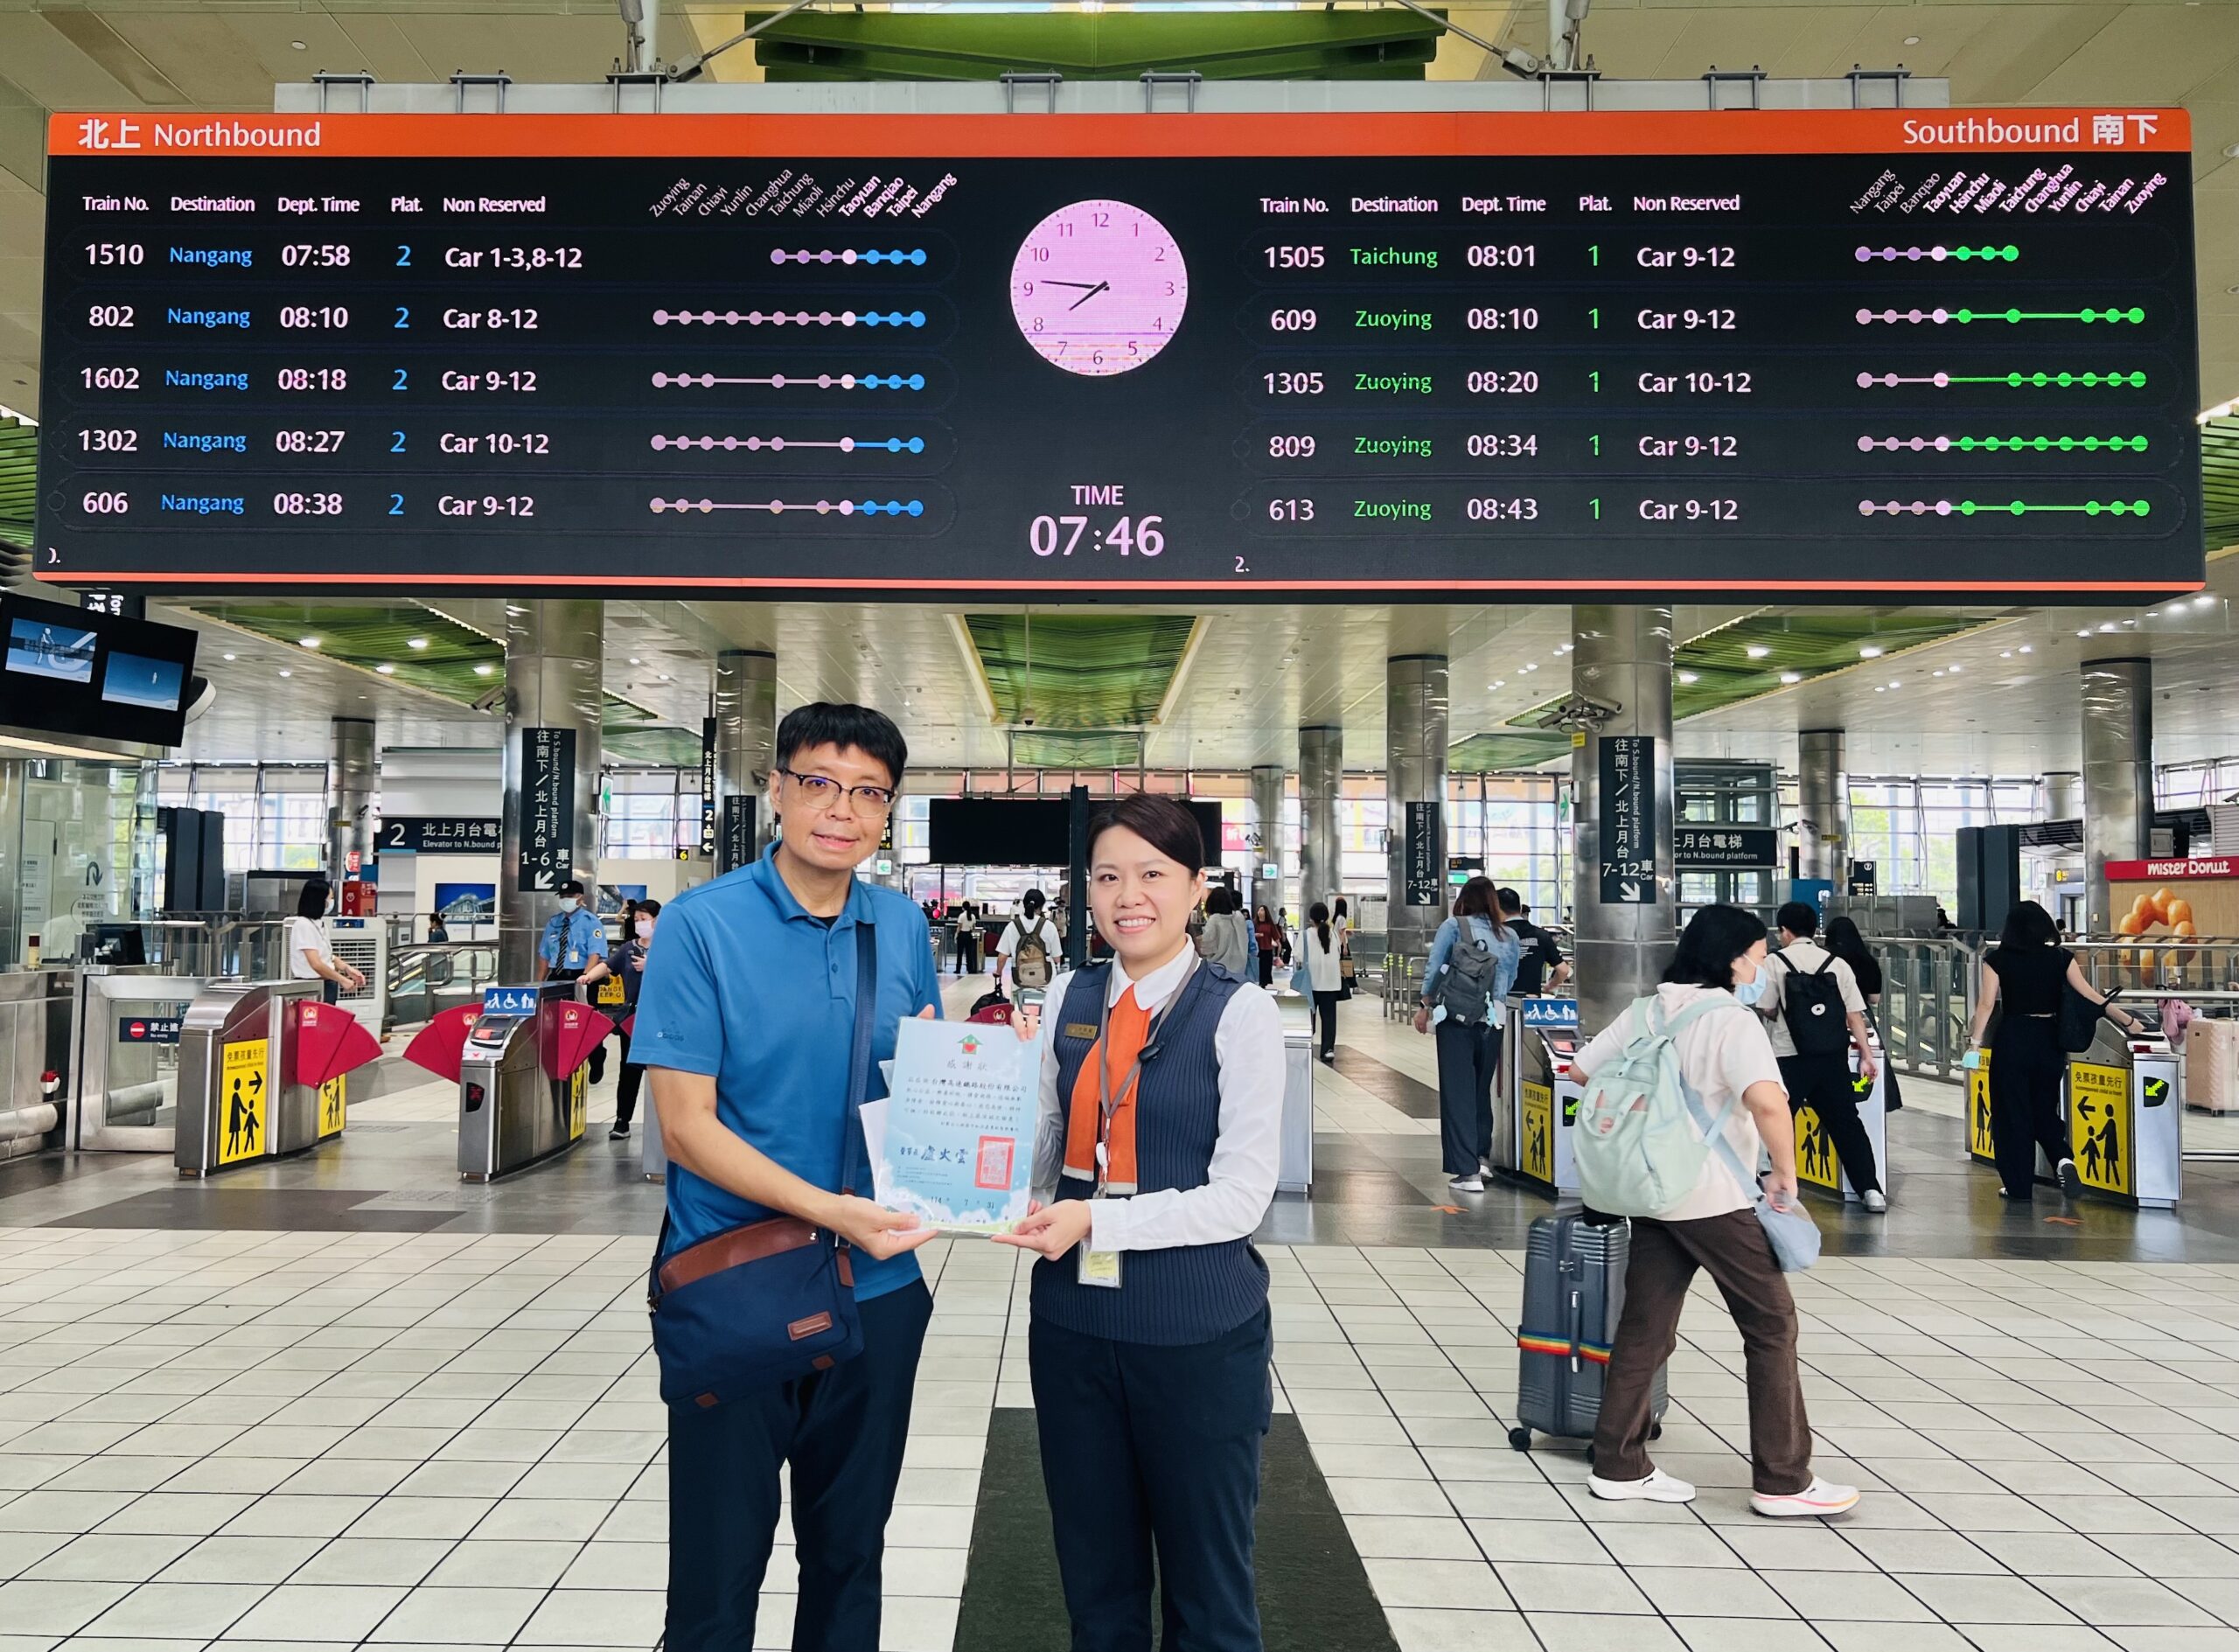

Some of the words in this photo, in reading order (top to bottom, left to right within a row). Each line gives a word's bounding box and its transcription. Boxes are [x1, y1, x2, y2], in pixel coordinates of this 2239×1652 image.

[78, 119, 141, 150] 北上
[154, 122, 320, 146] Northbound
[1904, 117, 2079, 144] Southbound
[2092, 114, 2158, 144] 南下
[649, 177, 690, 218] Zuoying
[745, 169, 793, 217] Changhua
[768, 173, 813, 217] Taichung
[817, 178, 856, 218] Hsinchu
[838, 175, 882, 218] Taoyuan
[863, 177, 904, 218] Banqiao
[911, 172, 957, 218] Nangang
[1849, 169, 1895, 215] Nangang
[1874, 181, 1906, 213] Taipei
[1900, 172, 1941, 214] Banqiao
[1923, 171, 1967, 213] Taoyuan
[1949, 171, 1991, 213] Hsinchu
[1973, 179, 2007, 213] Miaoli
[1998, 167, 2047, 213] Taichung
[2025, 163, 2074, 213] Changhua
[2047, 179, 2083, 213] Yunlin
[2075, 178, 2108, 213] Chiayi
[2098, 178, 2134, 213] Tainan
[2124, 171, 2167, 215] Zuoying
[82, 195, 120, 210] Train
[124, 197, 149, 211] No.
[171, 196, 255, 211] Destination
[278, 198, 317, 215] Dept.
[321, 197, 359, 212] Time
[392, 196, 422, 212] Plat.
[443, 198, 475, 212] Non
[479, 196, 545, 212] Reserved
[673, 183, 708, 218] Tainan
[698, 185, 729, 217] Chiayi
[720, 185, 752, 217] Yunlin
[793, 186, 824, 217] Miaoli
[887, 185, 918, 218] Taipei
[1260, 197, 1299, 213] Train
[1304, 198, 1329, 212] No.
[1352, 196, 1438, 212] Destination
[1462, 198, 1503, 214] Dept.
[1506, 196, 1546, 211] Time
[1580, 195, 1612, 211] Plat.
[1634, 197, 1666, 211] Non
[1671, 194, 1740, 211] Reserved
[1057, 223, 1073, 237] 11
[1092, 213, 1109, 227] 12
[1133, 223, 1139, 237] 1
[86, 244, 143, 264] 1510
[171, 247, 252, 267] Nangang
[282, 245, 350, 266] 07:58
[396, 246, 410, 266] 2
[445, 247, 483, 267] Car
[491, 248, 582, 271] 1-3,8-12
[1030, 247, 1050, 261] 10
[1154, 247, 1165, 261] 2
[1265, 247, 1324, 268] 1505
[1350, 247, 1438, 268] Taichung
[1468, 246, 1534, 266] 08:01
[1588, 246, 1597, 266] 1
[1637, 247, 1677, 267] Car
[1684, 247, 1734, 267] 9-12
[1023, 282, 1034, 296] 9
[1165, 282, 1175, 296] 3
[89, 306, 134, 326] 802
[168, 308, 250, 328] Nangang
[281, 307, 348, 328] 08:10
[394, 307, 409, 328] 2
[443, 309, 481, 328] Car
[487, 309, 537, 329] 8-12
[1034, 317, 1043, 331] 8
[1153, 317, 1162, 331] 4
[1272, 310, 1316, 331] 609
[1356, 310, 1432, 330] Zuoying
[1468, 309, 1538, 329] 08:10
[1589, 309, 1598, 329] 1
[1638, 310, 1677, 329] Car
[1684, 310, 1735, 329] 9-12
[1057, 341, 1068, 356] 7
[1093, 350, 1103, 365] 6
[1128, 341, 1137, 356] 5
[81, 368, 139, 388] 1602
[166, 370, 248, 390] Nangang
[278, 369, 346, 390] 08:18
[393, 369, 407, 390] 2
[443, 371, 479, 390] Car
[486, 372, 536, 391] 9-12
[1264, 373, 1323, 394] 1305
[1356, 373, 1432, 394] Zuoying
[1468, 372, 1538, 393] 08:20
[1589, 372, 1598, 392] 1
[1639, 373, 1678, 392] Car
[1685, 373, 1751, 392] 10-12
[79, 430, 137, 451] 1302
[164, 432, 246, 452] Nangang
[276, 431, 345, 452] 08:27
[391, 431, 406, 452] 2
[440, 434, 478, 453] Car
[485, 434, 548, 453] 10-12
[1270, 436, 1315, 457] 809
[1355, 436, 1431, 457] Zuoying
[1468, 435, 1538, 456] 08:34
[1589, 436, 1598, 456] 1
[1639, 436, 1678, 456] Car
[1685, 436, 1737, 456] 9-12
[83, 492, 128, 513] 606
[162, 495, 244, 514] Nangang
[274, 493, 342, 514] 08:38
[389, 494, 404, 514] 2
[1071, 485, 1124, 505] TIME
[438, 496, 477, 515] Car
[483, 497, 533, 516] 9-12
[1270, 499, 1314, 520] 613
[1354, 499, 1431, 520] Zuoying
[1468, 498, 1538, 519] 08:43
[1590, 498, 1599, 519] 1
[1640, 500, 1678, 519] Car
[1685, 500, 1738, 519] 9-12
[1030, 516, 1164, 556] 07:46
[705, 810, 713, 820] 2
[390, 824, 405, 846] 2
[521, 851, 550, 866] 1-6
[556, 849, 569, 862] 車
[1726, 852, 1758, 861] platform
[1603, 863, 1639, 877] 7-12
[1641, 860, 1653, 873] 車
[2188, 861, 2230, 875] Donut
[1408, 880, 1430, 889] 7-12
[150, 1022, 179, 1032] 禁止進
